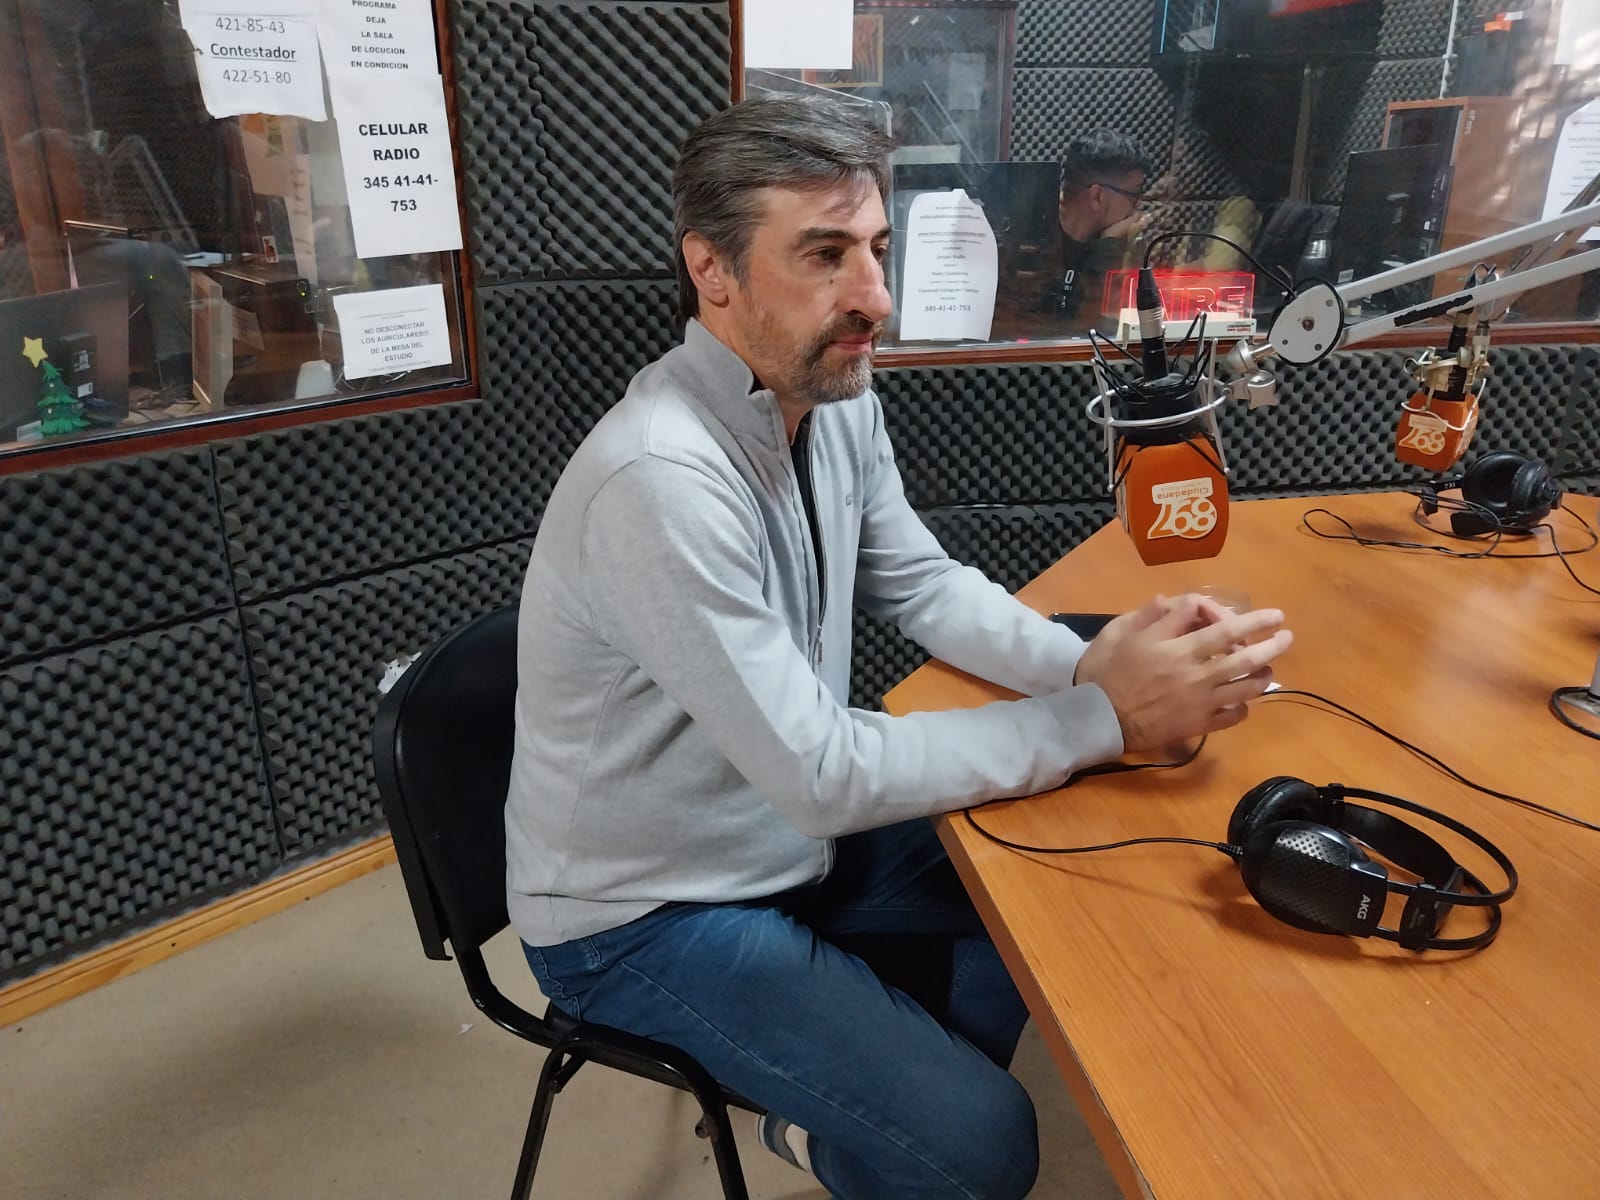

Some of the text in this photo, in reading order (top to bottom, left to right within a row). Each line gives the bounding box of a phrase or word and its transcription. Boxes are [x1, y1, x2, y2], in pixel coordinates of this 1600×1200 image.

[352, 0, 397, 9] PROGRAMA
[215, 16, 286, 34] 421-85-43
[365, 16, 386, 24] DEJA
[361, 31, 394, 40] LA SALA
[210, 43, 297, 60] Contestador
[351, 45, 406, 55] DE LOCUCION
[351, 60, 408, 70] EN CONDICION
[222, 70, 291, 85] 422-51-80
[358, 123, 429, 137] CELULAR
[373, 147, 420, 161] RADIO
[363, 174, 438, 189] 345 41-41-
[390, 199, 418, 212] 753
[375, 321, 425, 334] DESCONECTAR
[361, 337, 375, 345] LOS
[384, 352, 413, 362] ESTUDIO
[1156, 487, 1209, 501] Ciudadana
[1357, 894, 1371, 921] AKG
